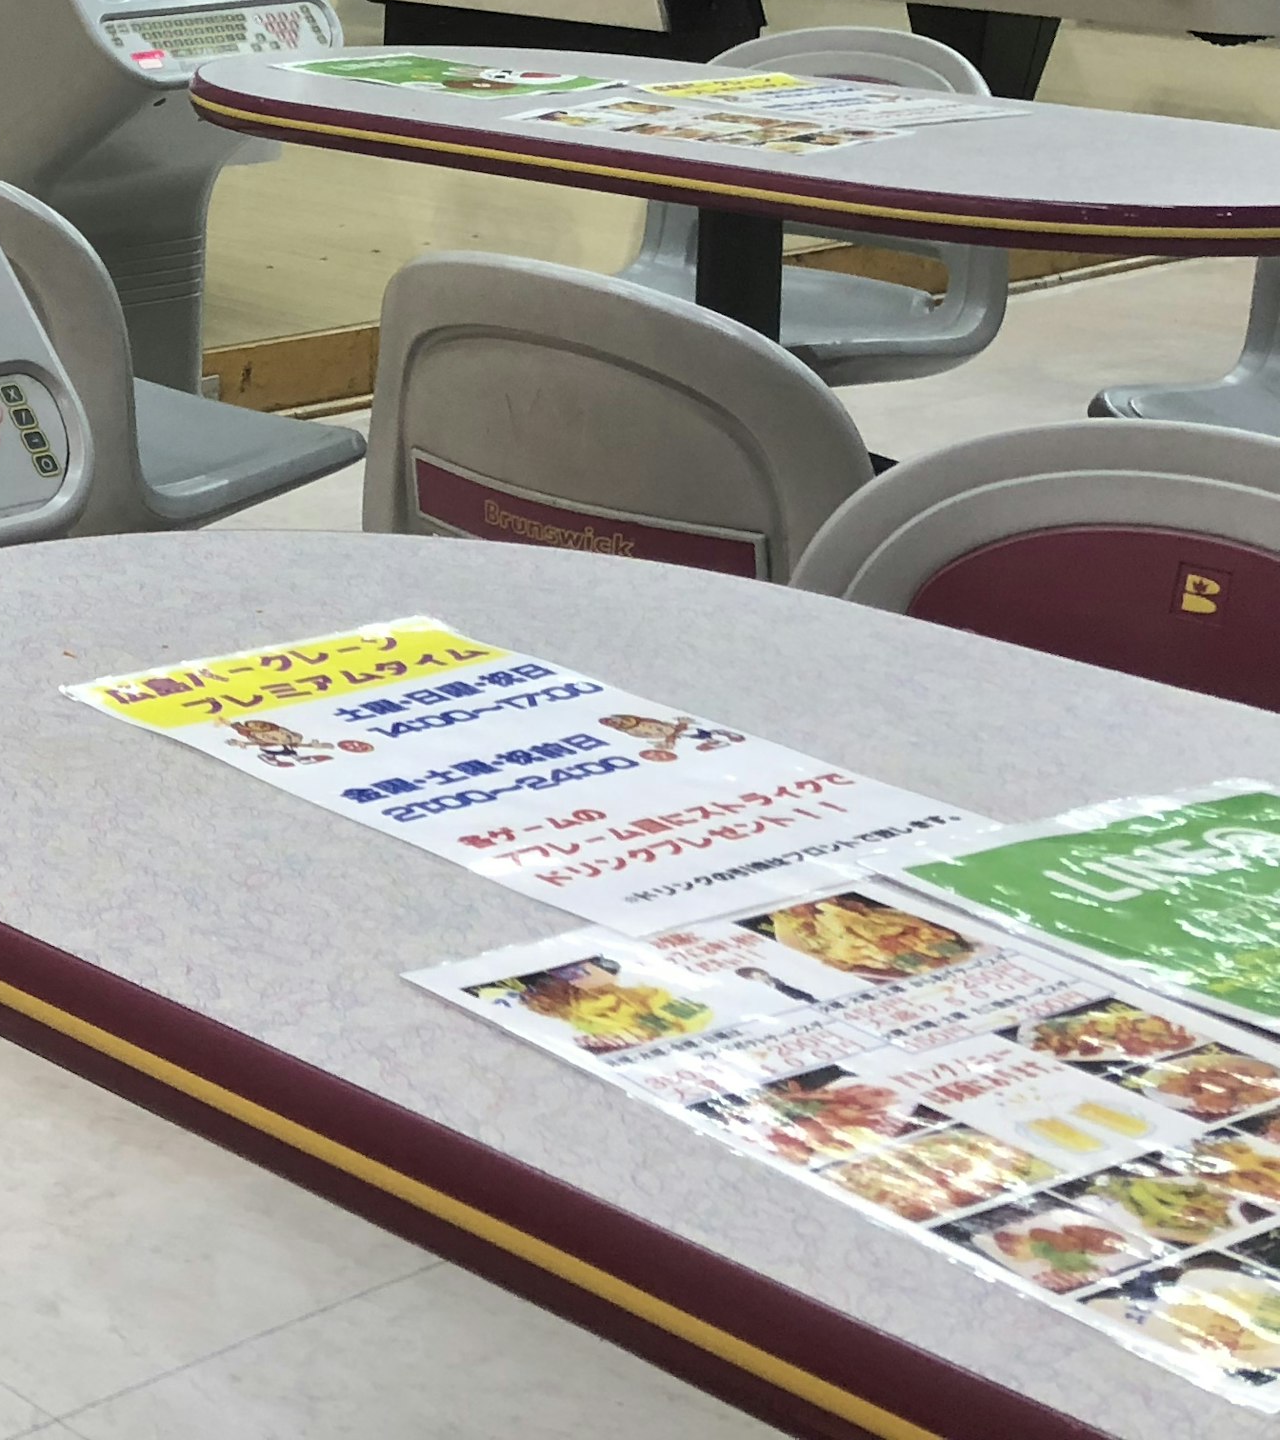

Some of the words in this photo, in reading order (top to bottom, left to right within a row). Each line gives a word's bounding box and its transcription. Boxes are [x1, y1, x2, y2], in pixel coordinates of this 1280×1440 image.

[484, 499, 635, 558] Brunswick
[181, 647, 491, 715] プレミアムタイム
